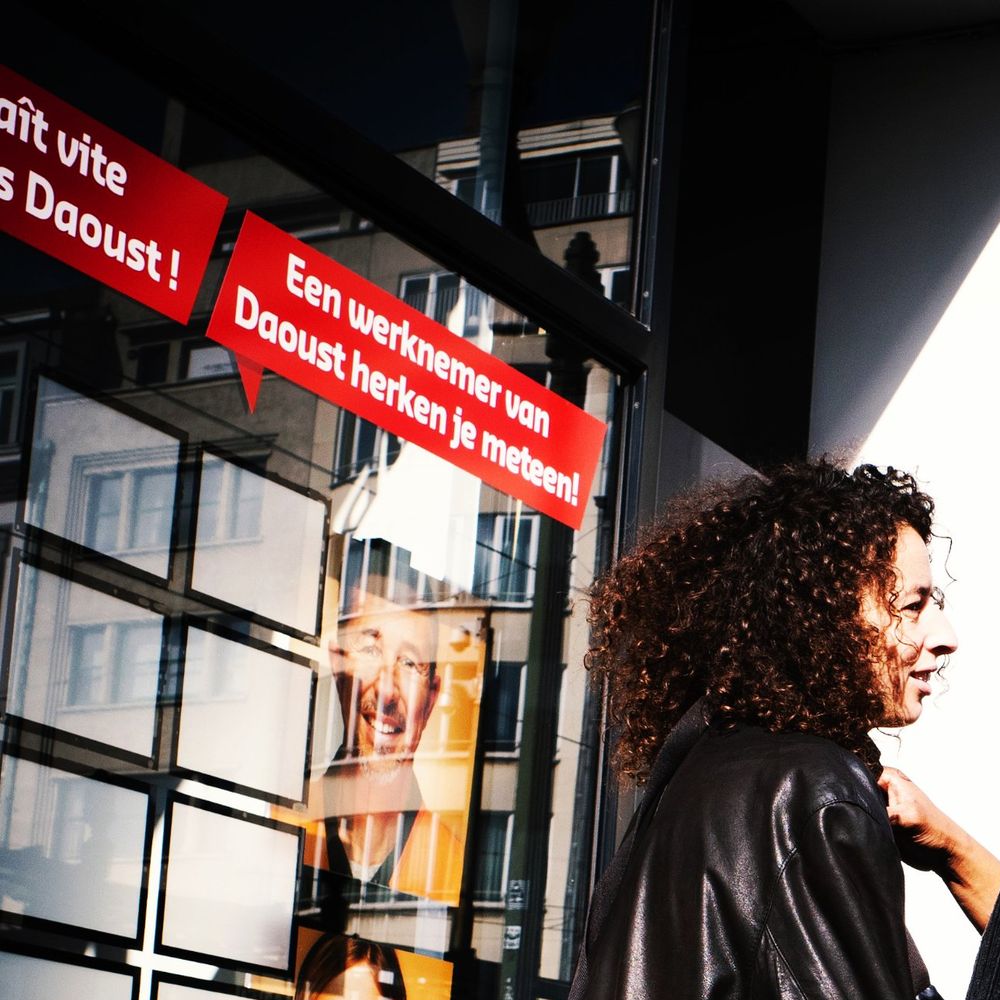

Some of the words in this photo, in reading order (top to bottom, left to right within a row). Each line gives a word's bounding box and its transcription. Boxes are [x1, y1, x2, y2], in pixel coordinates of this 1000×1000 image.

[25, 170, 162, 283] Daoust
[57, 130, 128, 196] vite
[234, 284, 346, 383] Daoust
[351, 349, 447, 435] herken
[450, 406, 477, 450] je
[481, 430, 580, 506] meteen!
[286, 253, 342, 319] Een
[348, 298, 502, 408] werknemer
[505, 389, 550, 438] van
